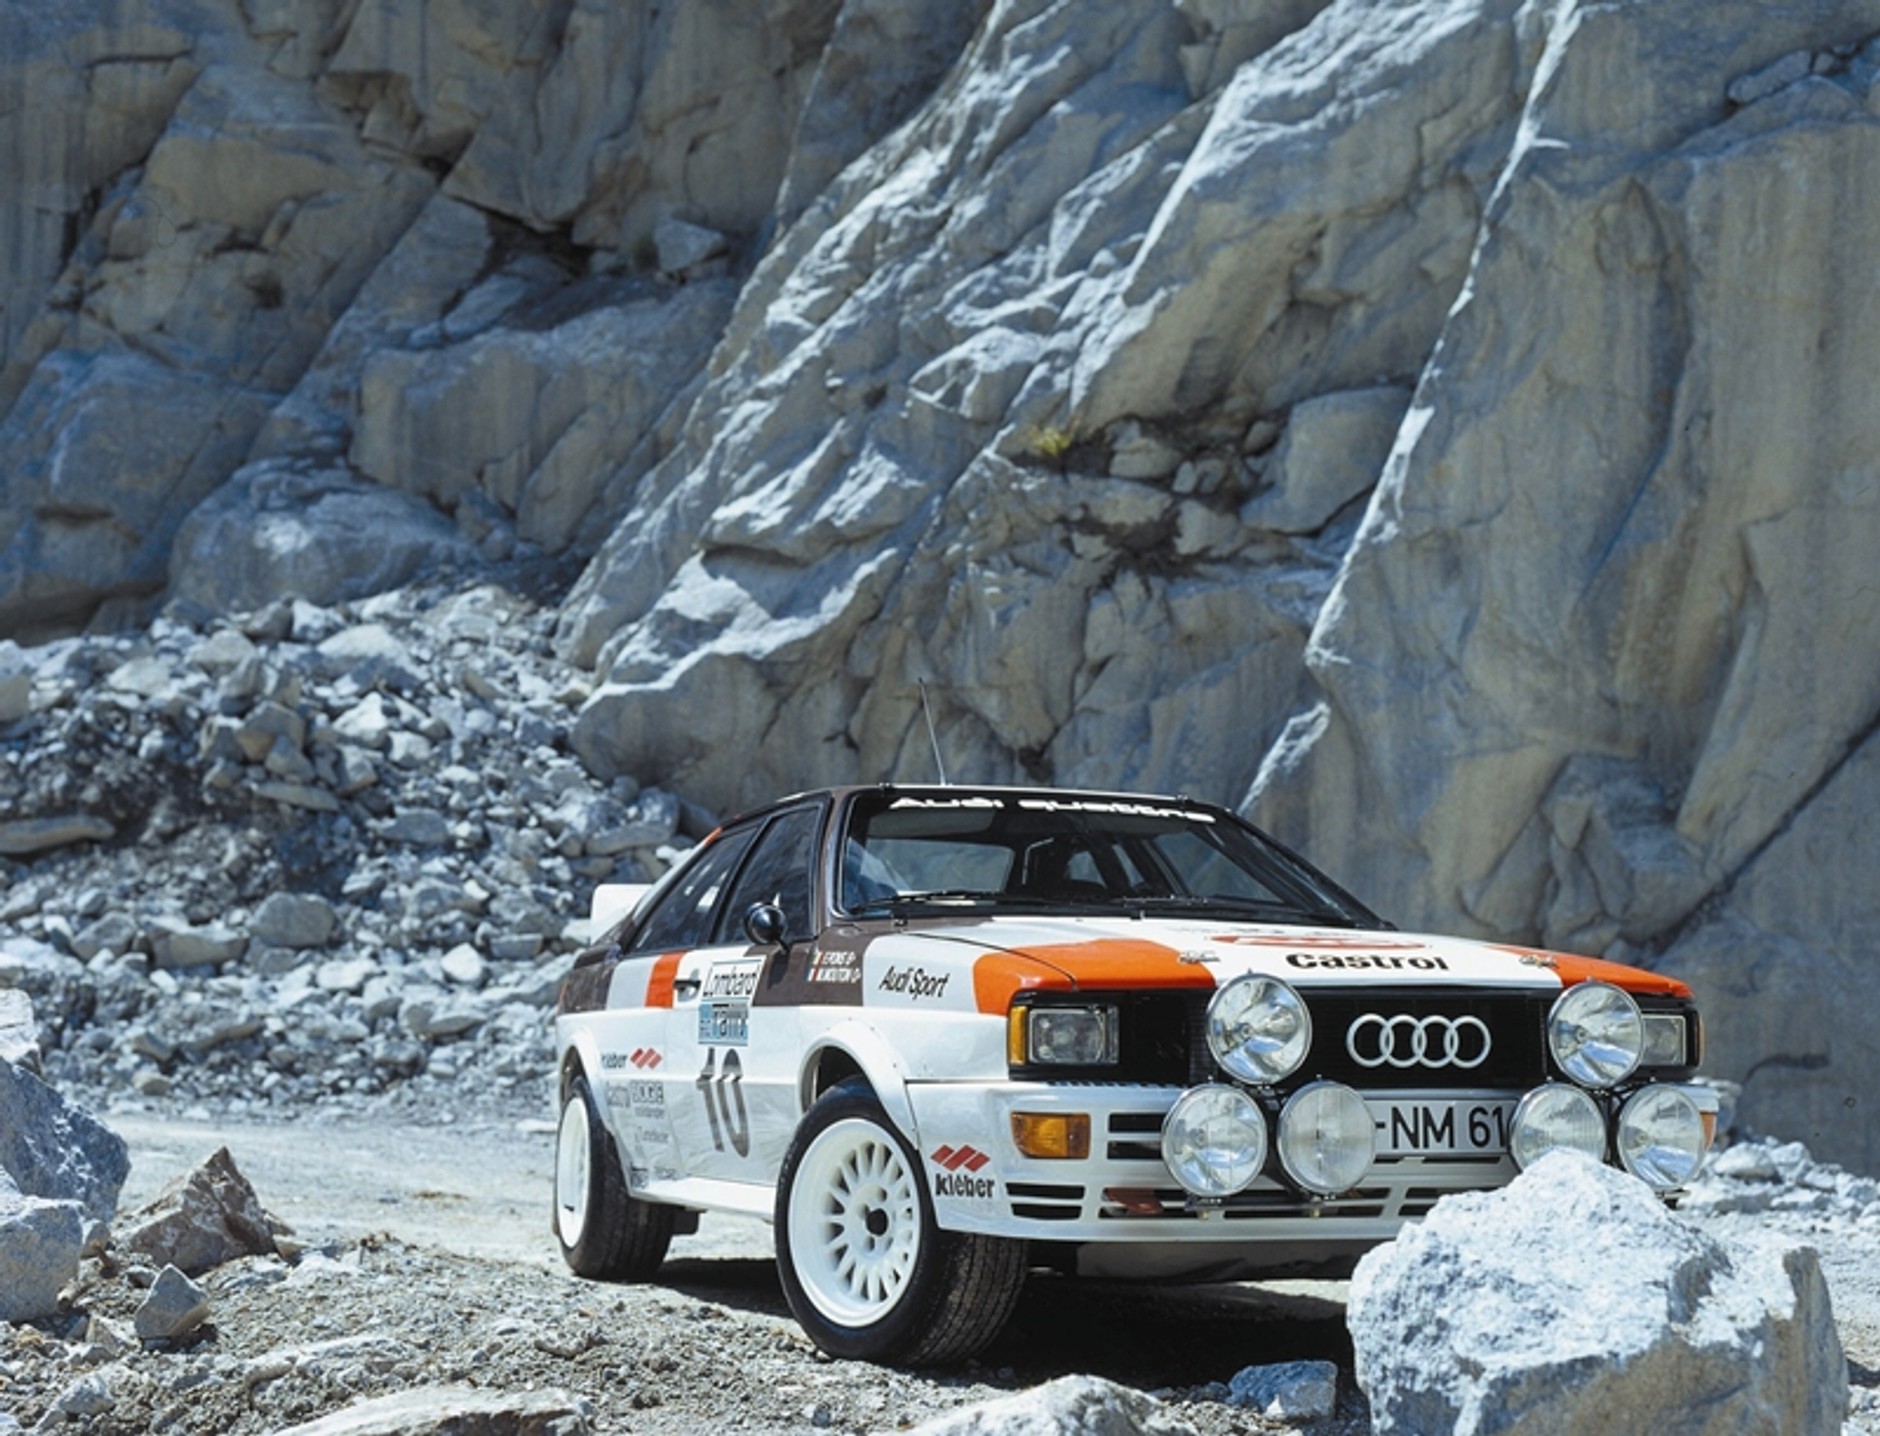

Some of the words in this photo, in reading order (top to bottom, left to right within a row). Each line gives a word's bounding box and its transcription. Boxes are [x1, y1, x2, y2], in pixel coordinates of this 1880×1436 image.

[890, 797, 1004, 810] Audi
[1286, 952, 1449, 971] Castrol
[703, 963, 760, 997] Lombard
[879, 966, 912, 993] Audi
[908, 968, 950, 1001] Sport
[695, 1046, 750, 1160] 10
[1468, 1106, 1507, 1148] 61
